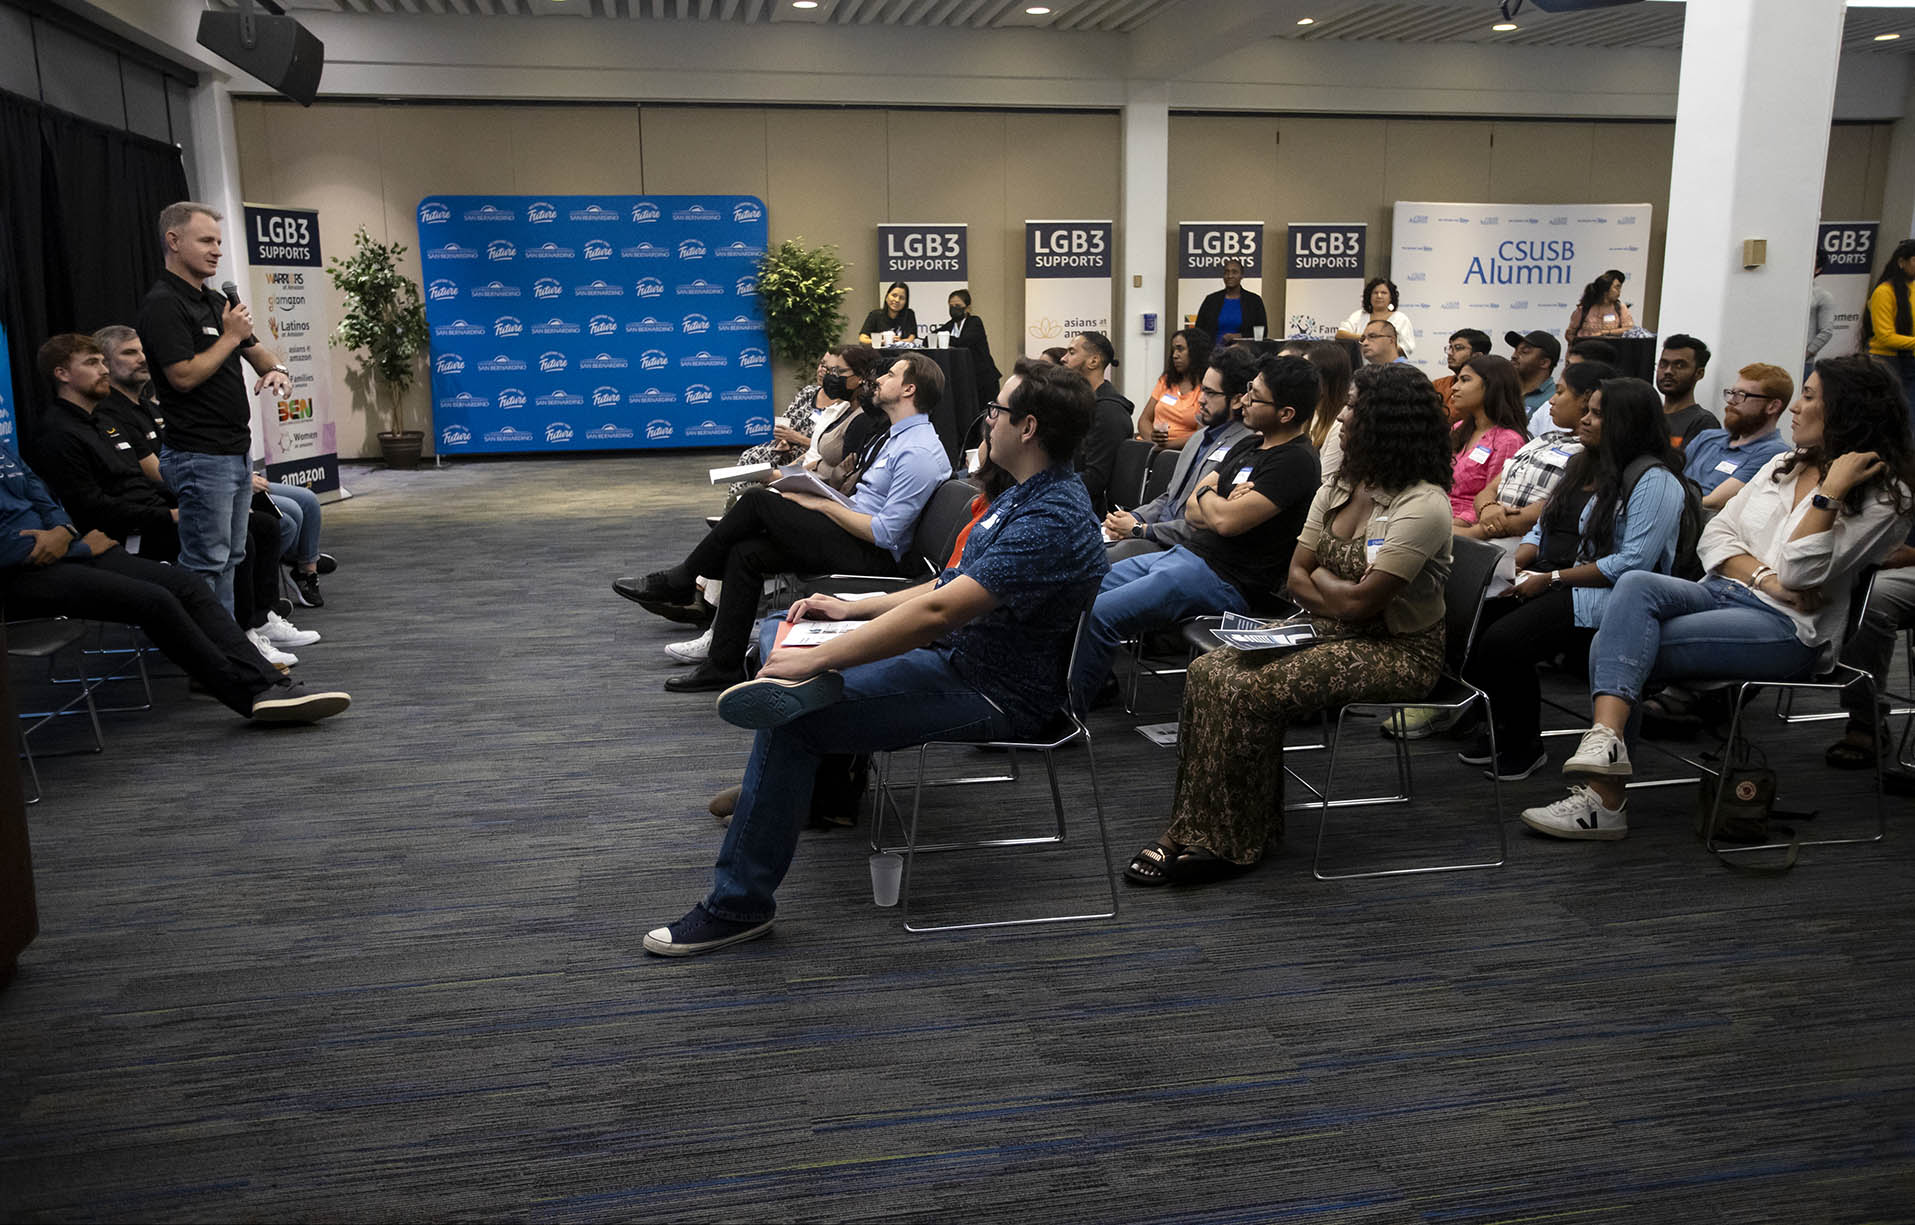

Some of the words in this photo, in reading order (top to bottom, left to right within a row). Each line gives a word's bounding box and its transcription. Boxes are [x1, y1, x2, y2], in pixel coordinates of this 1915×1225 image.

[420, 209, 451, 221] Future
[528, 209, 557, 222] Future
[632, 209, 660, 221] Future
[733, 209, 760, 221] Future
[257, 215, 310, 245] LGB3
[888, 234, 960, 257] LGB3
[1034, 230, 1105, 253] LGB3
[1188, 231, 1257, 254] LGB3
[1296, 232, 1360, 255] LGB3
[1823, 230, 1872, 252] GB3
[259, 245, 311, 260] SUPPORTS
[487, 246, 516, 259] Future
[584, 246, 613, 259] Future
[678, 245, 706, 258] Future
[1498, 240, 1575, 261] CSUSB
[889, 259, 959, 271] SUPPORTS
[1035, 256, 1104, 267] SUPPORTS
[1296, 257, 1358, 268] SUPPORTS
[1463, 256, 1571, 284] Alumni
[428, 285, 458, 298] Future
[533, 284, 563, 297] Future
[636, 283, 664, 296] Future
[281, 320, 310, 331] Latinos
[493, 322, 523, 335] Future
[588, 321, 617, 334] Future
[681, 319, 710, 332] Future
[1064, 317, 1097, 328] asians
[436, 359, 465, 372] Future
[539, 357, 568, 370] Future
[640, 355, 668, 368] Future
[738, 354, 766, 366] Future
[498, 394, 527, 407] Future
[592, 392, 620, 405] Future
[684, 390, 712, 403] Future
[545, 428, 574, 441] Future
[645, 425, 673, 438] Future
[744, 422, 772, 435] Future
[293, 432, 318, 441] Women
[442, 430, 471, 443] Future
[281, 466, 325, 486] amazon
